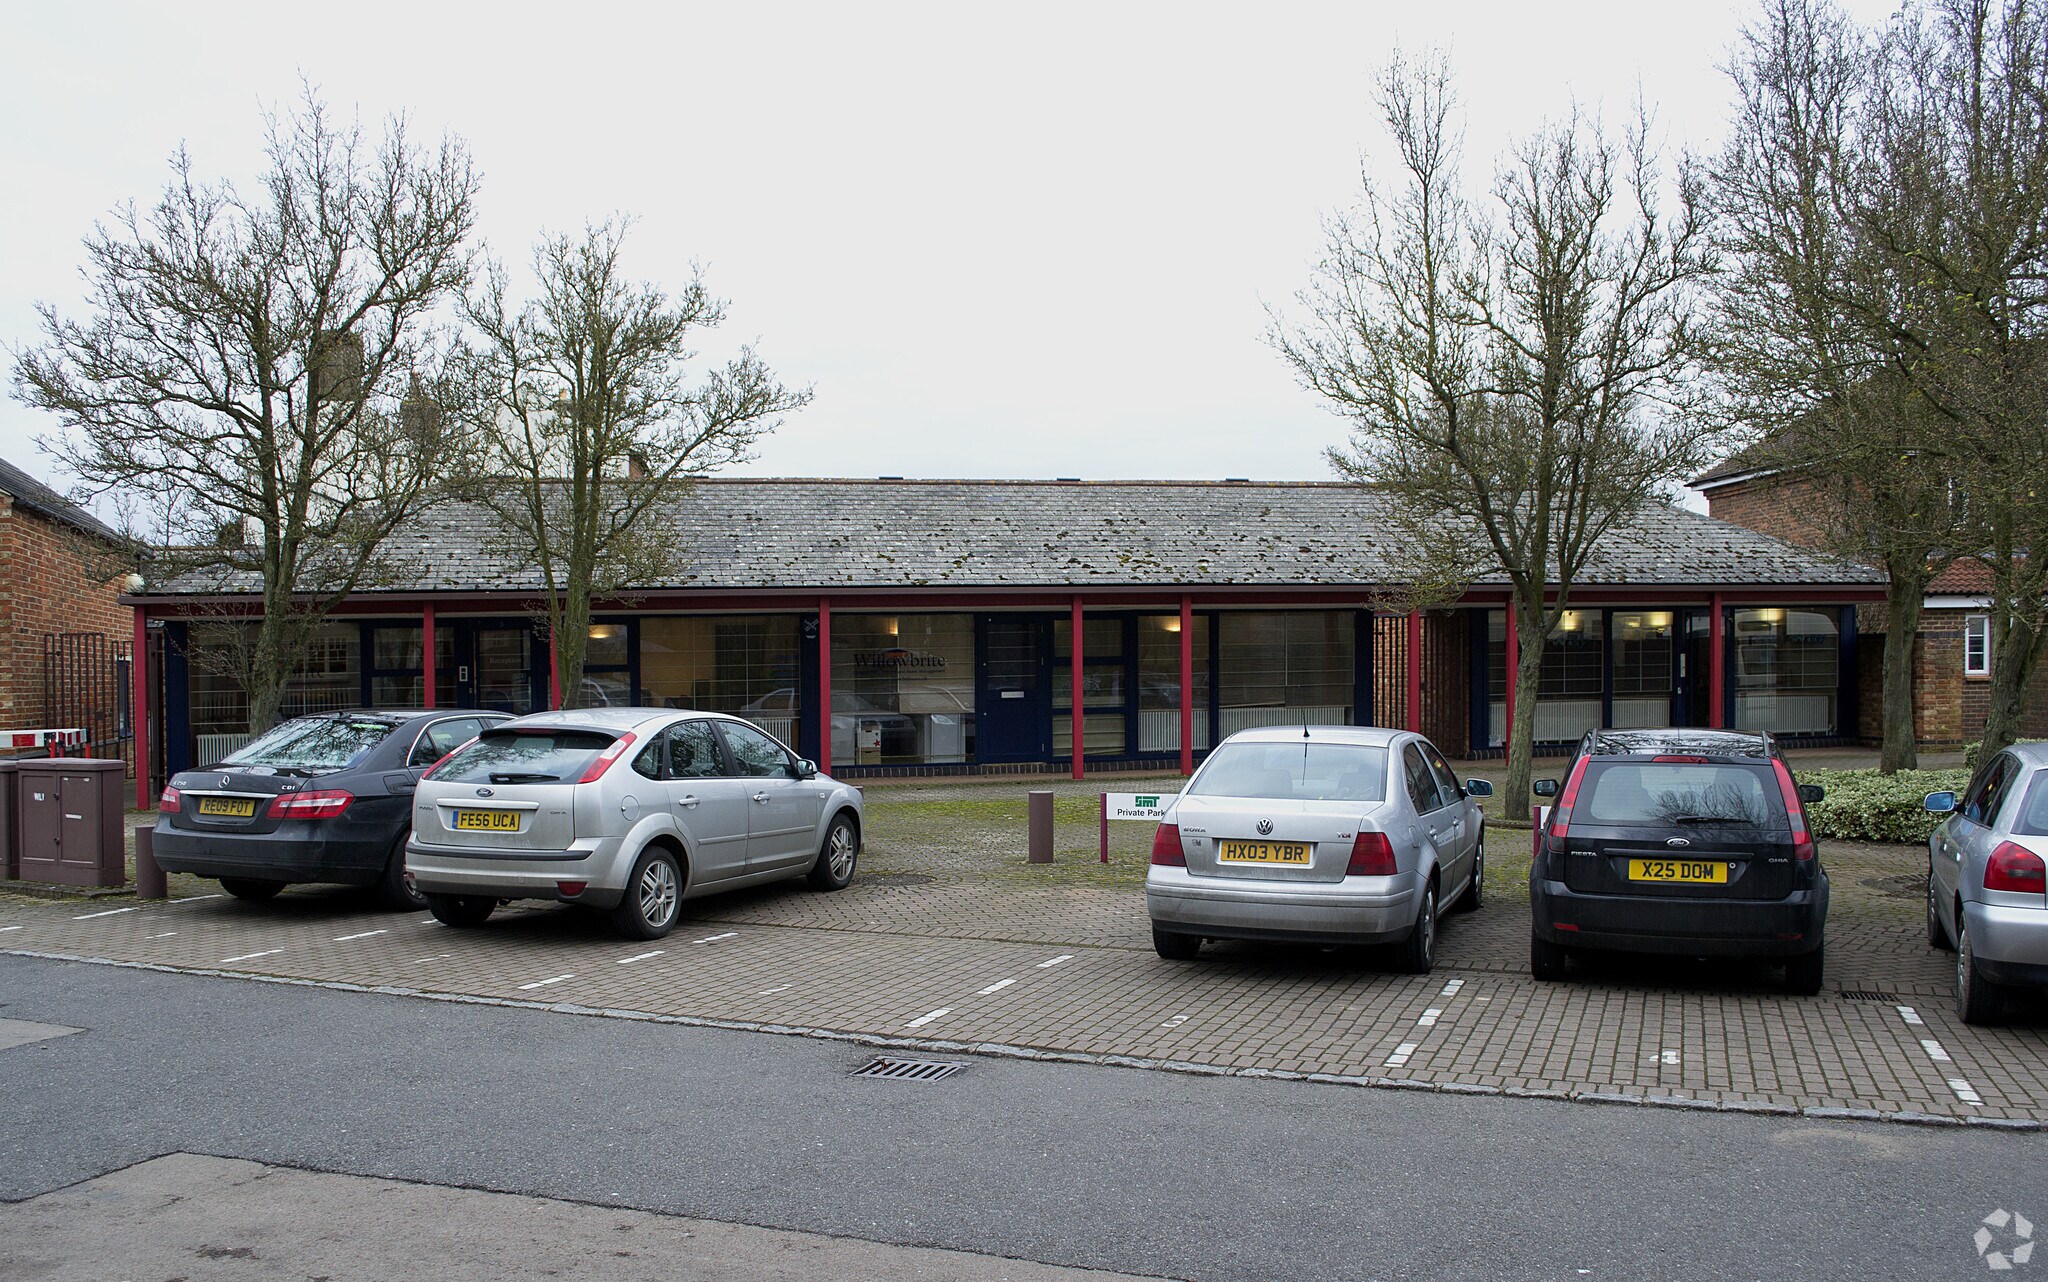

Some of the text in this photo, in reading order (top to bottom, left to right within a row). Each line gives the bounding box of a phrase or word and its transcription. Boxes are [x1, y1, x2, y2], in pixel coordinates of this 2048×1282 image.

[489, 656, 522, 665] Reception
[854, 652, 946, 668] Willowbrite
[203, 800, 250, 814] RE09 FOT
[1117, 808, 1166, 817] Private Park
[460, 813, 516, 828] FE56 UCA
[1226, 844, 1304, 861] HX03 YBR
[1642, 862, 1714, 880] X25 DOM
[1648, 1050, 1681, 1065] 4
